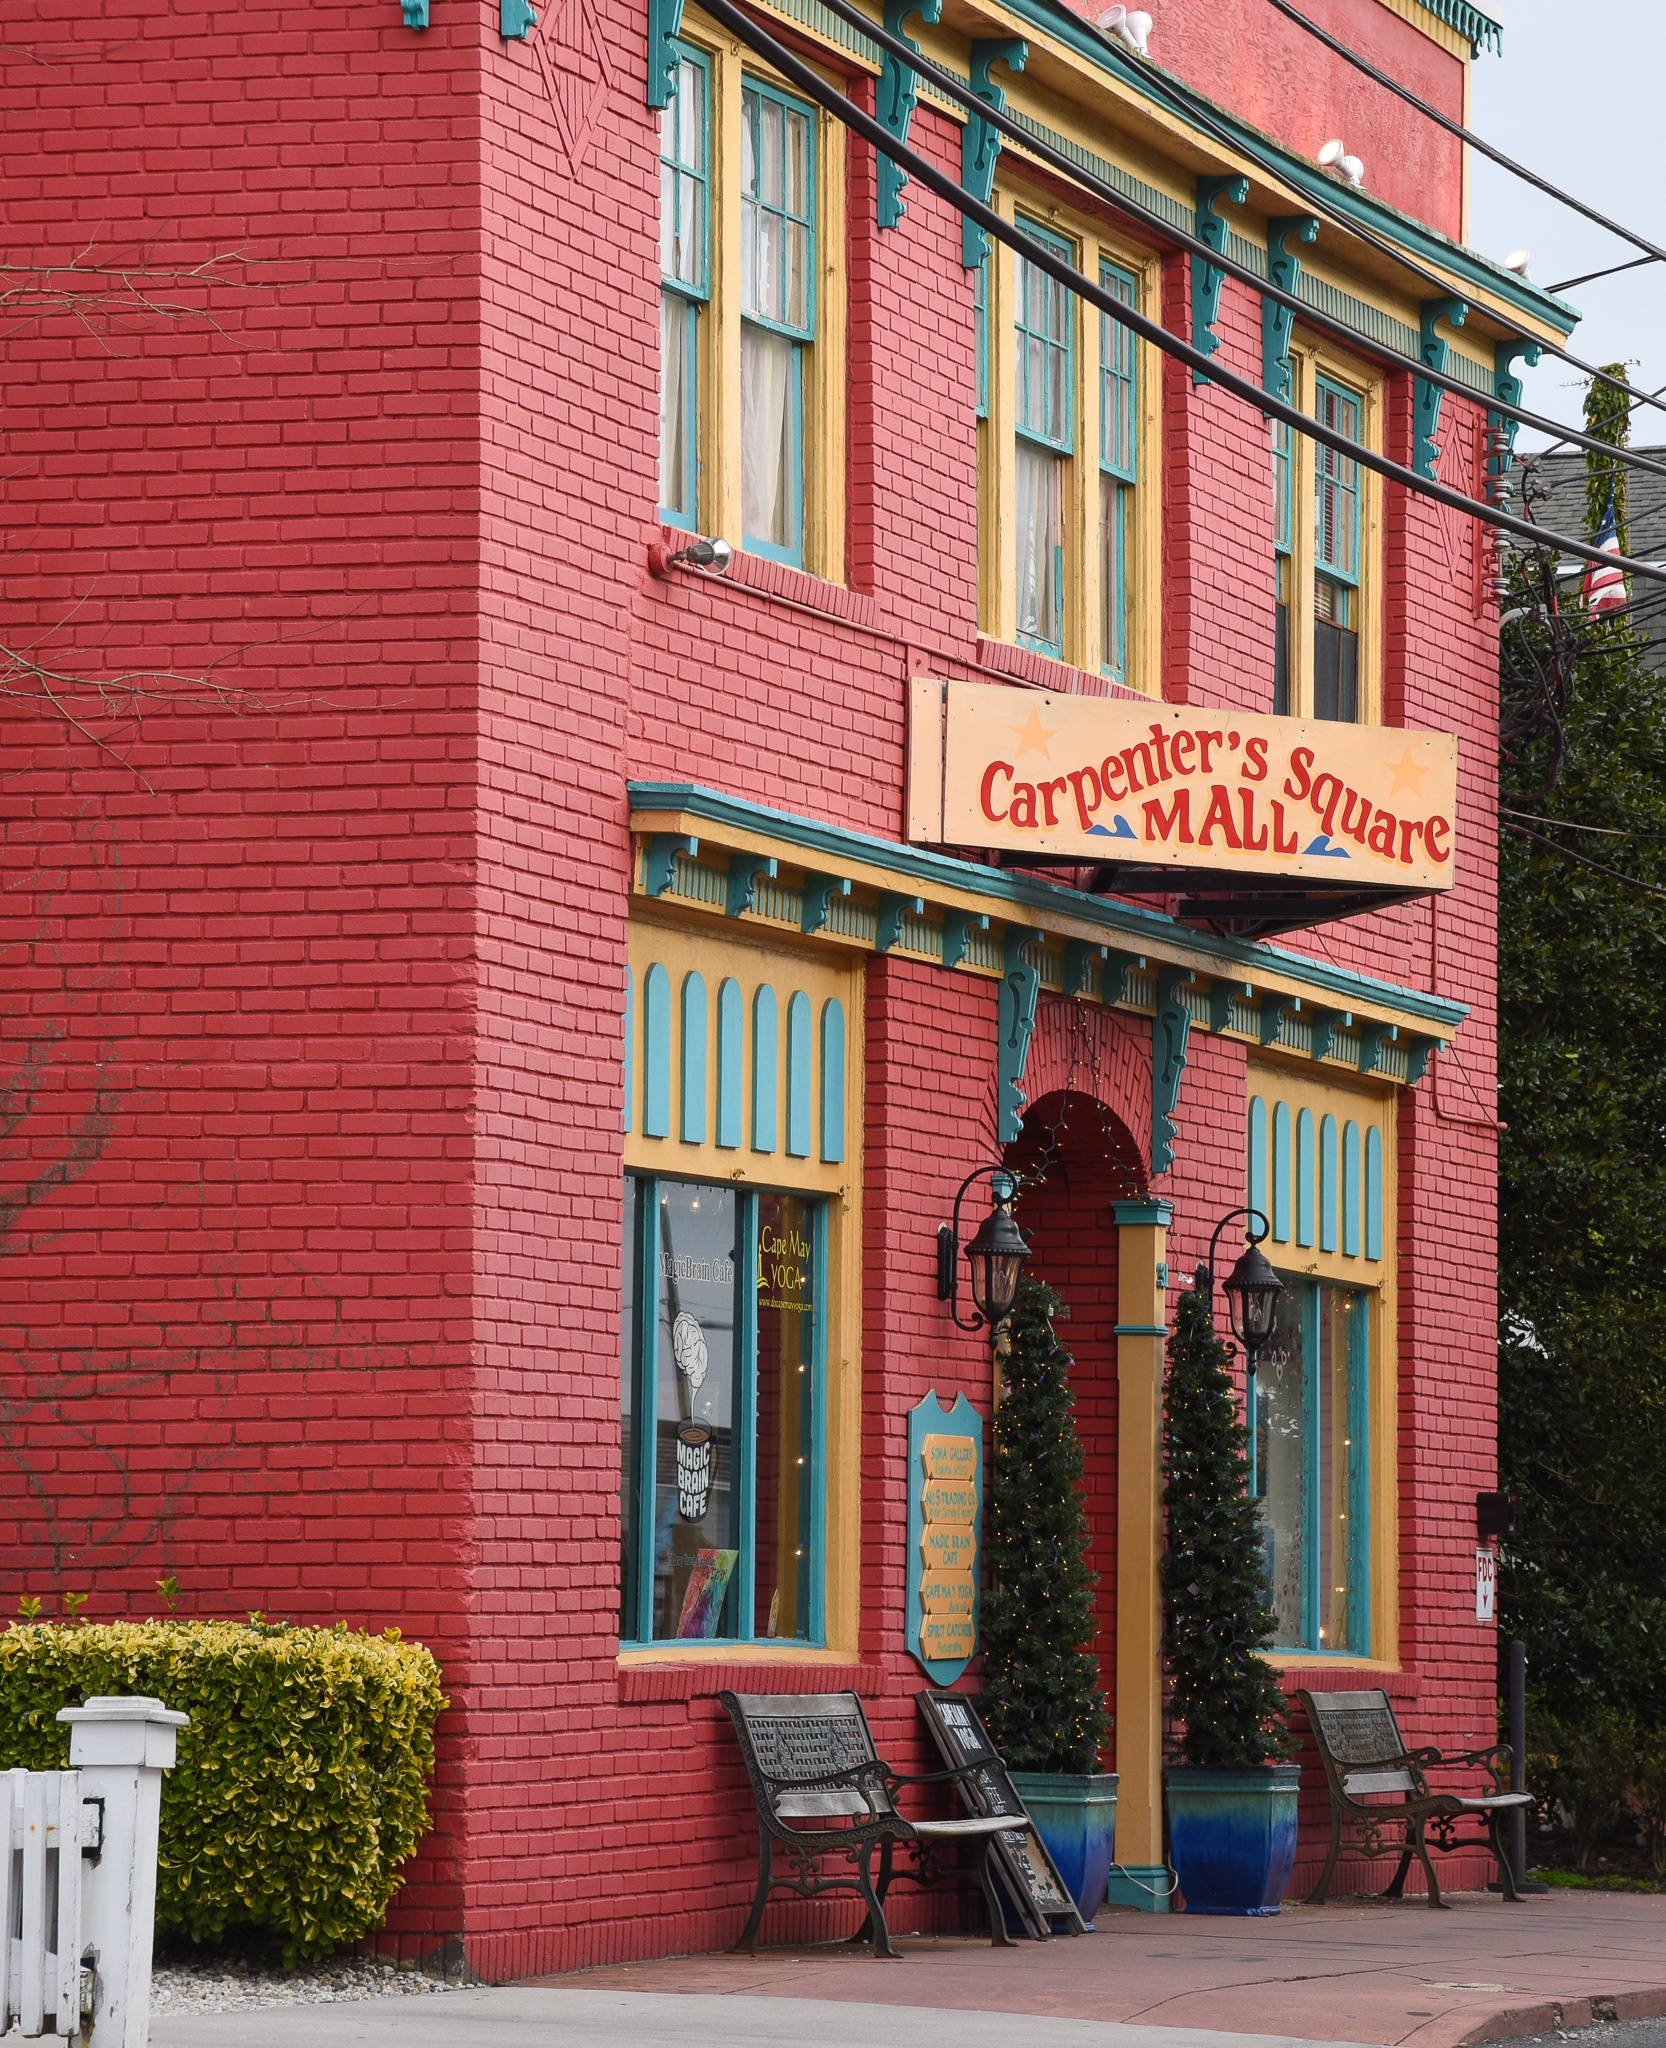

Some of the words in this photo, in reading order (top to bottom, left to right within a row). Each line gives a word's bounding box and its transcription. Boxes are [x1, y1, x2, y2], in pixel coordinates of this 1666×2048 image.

[980, 723, 1268, 829] Carpenter's
[1284, 746, 1451, 864] Square
[1141, 784, 1299, 854] MALL
[761, 1225, 787, 1260] Cape
[788, 1229, 811, 1264] May
[712, 1258, 733, 1285] Cafe
[771, 1263, 802, 1291] YOGA
[677, 1438, 710, 1471] MAGIC
[931, 1446, 948, 1461] SOMA
[950, 1446, 973, 1462] GALLERY
[678, 1464, 709, 1494] BRAIN
[680, 1490, 707, 1518] CAFE
[941, 1491, 967, 1506] TRADING
[929, 1534, 950, 1549] MAGIC
[951, 1535, 971, 1549] BRAIN
[943, 1550, 958, 1565] CAFE
[1478, 1557, 1493, 1583] FDC
[926, 1584, 941, 1599] CAPE
[941, 1584, 956, 1599] MAY
[957, 1584, 973, 1599] YOGA
[927, 1623, 945, 1638] SPIRIT
[946, 1623, 972, 1638] CATCHER
[953, 1727, 982, 1750] YOGA
